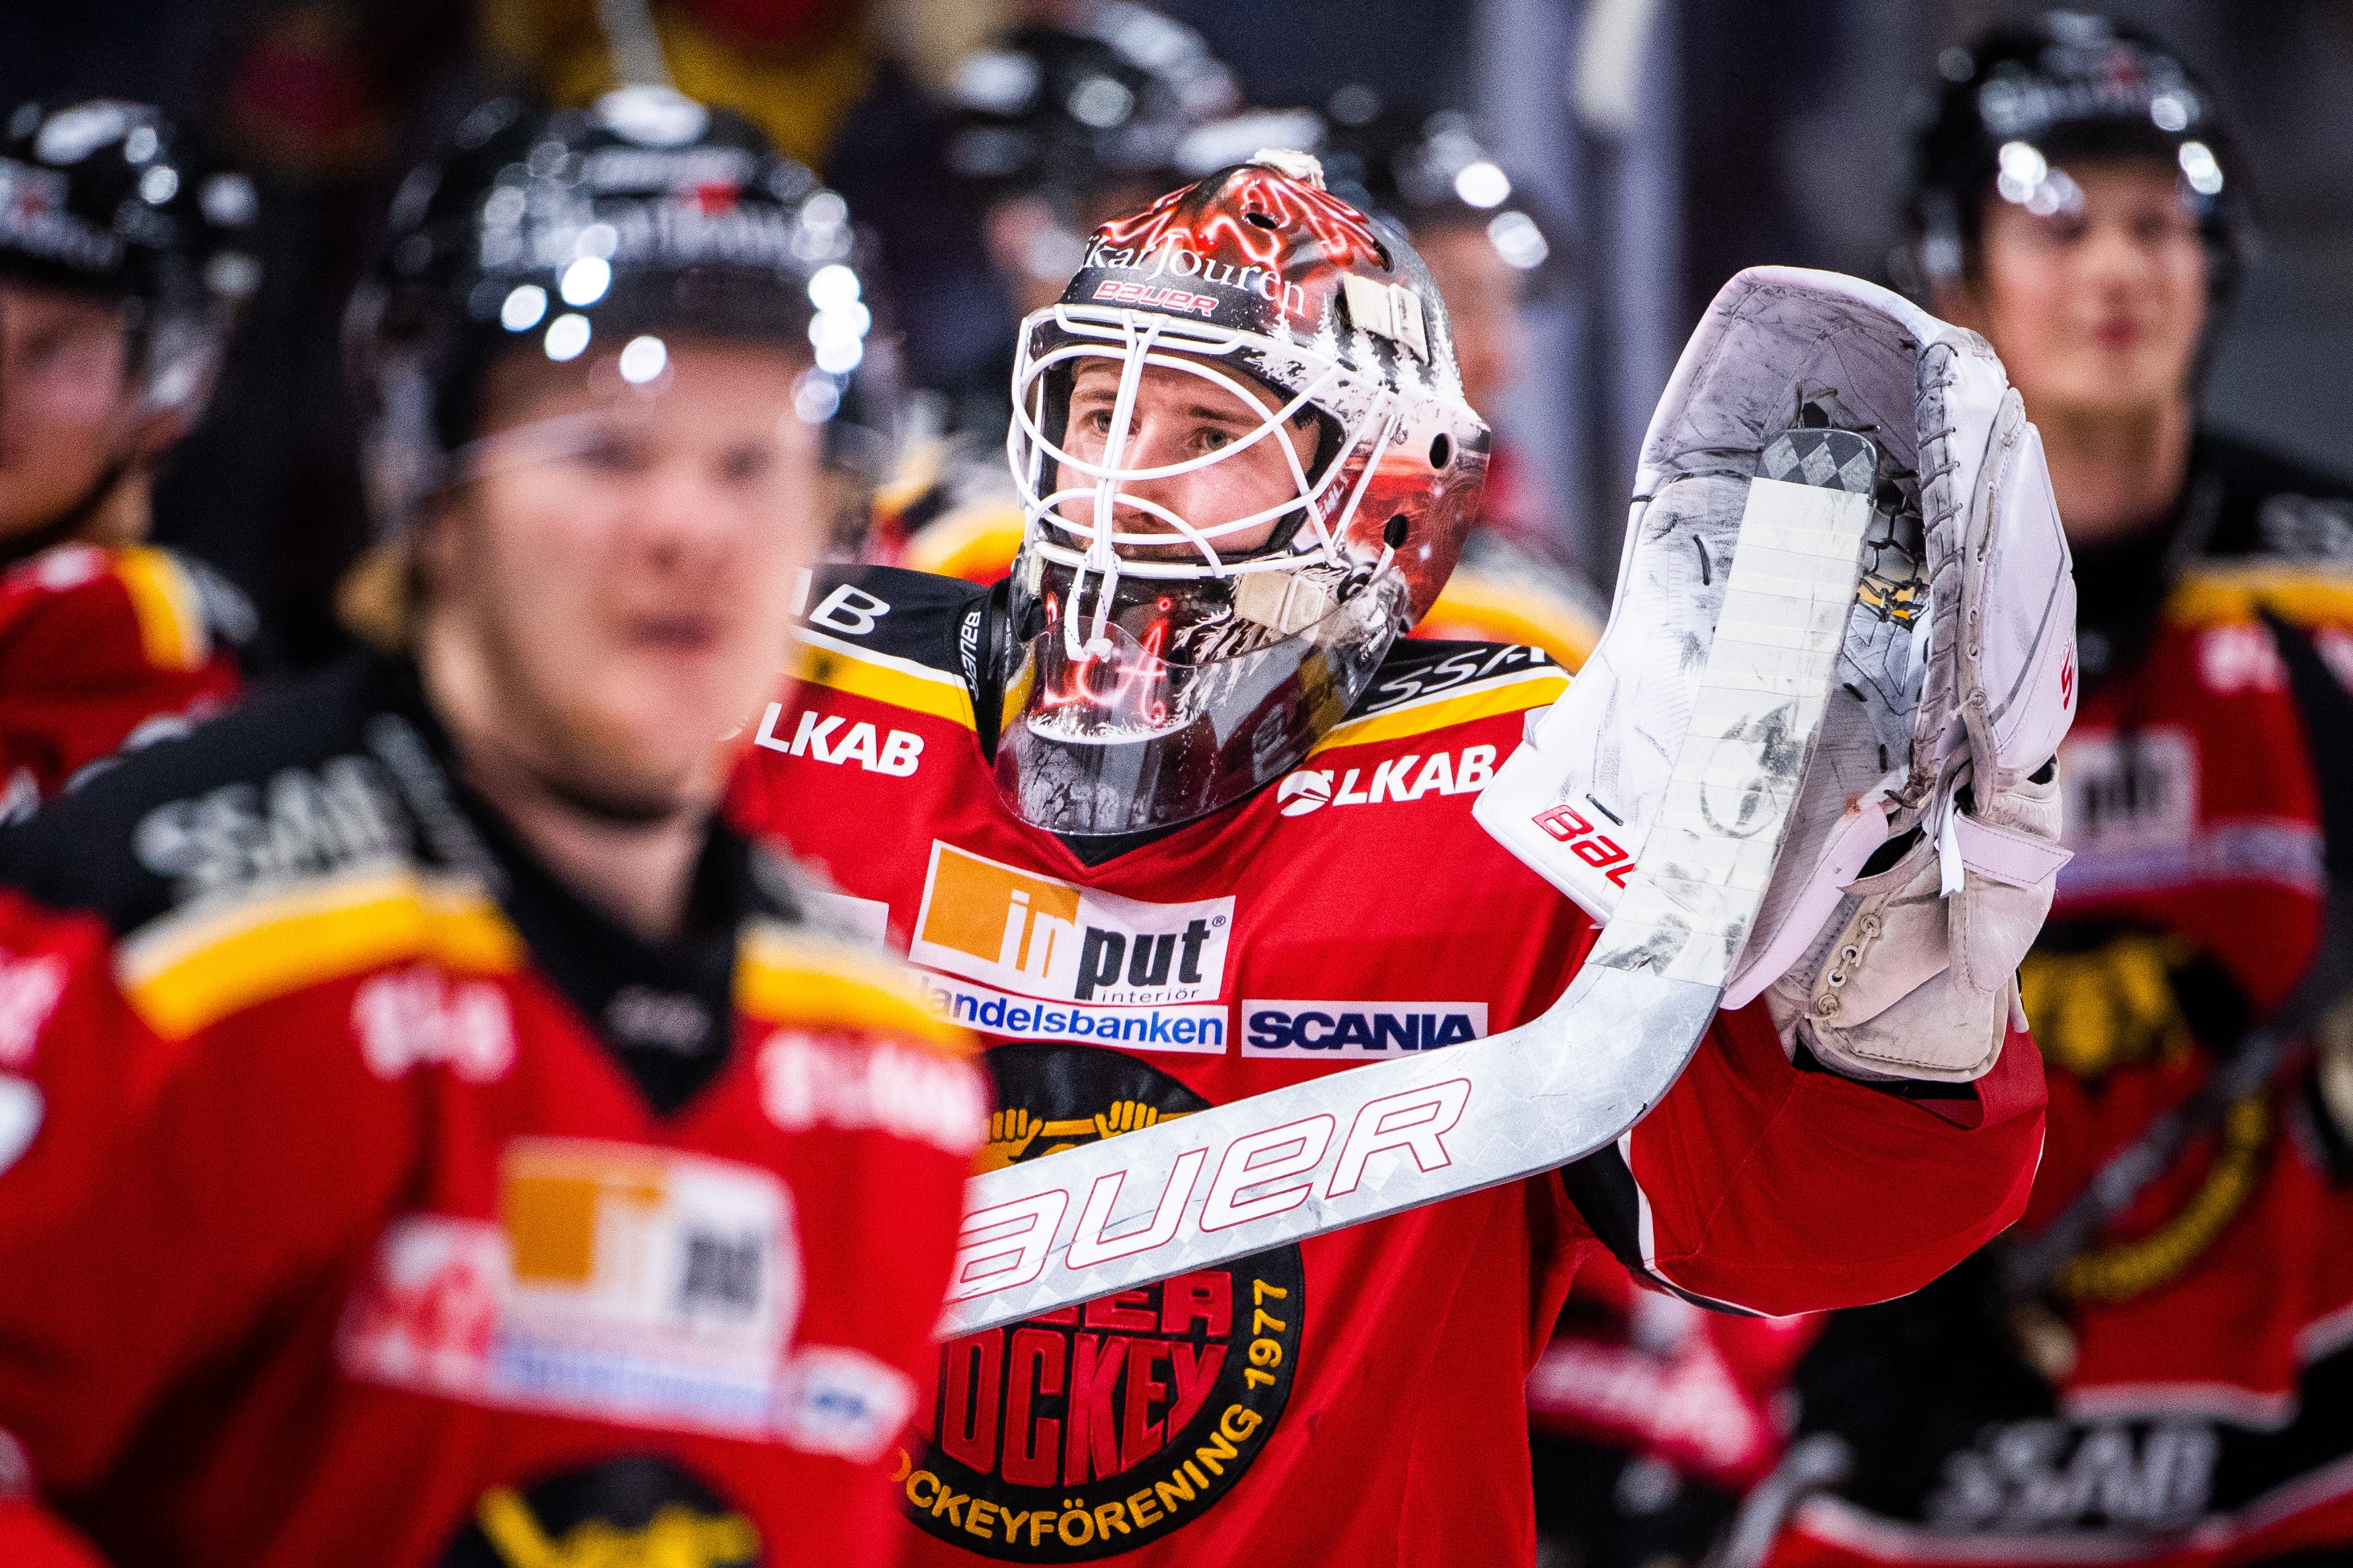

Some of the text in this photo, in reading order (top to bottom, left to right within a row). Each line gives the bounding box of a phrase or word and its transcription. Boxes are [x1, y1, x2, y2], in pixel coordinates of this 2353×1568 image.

[1092, 280, 1219, 318] BAUER
[1367, 645, 1545, 711] SSA
[754, 702, 925, 777] LKAB
[1332, 744, 1497, 807] LKAB
[921, 975, 1223, 1047] andelsbanken
[1102, 988, 1200, 1003] interiör
[1247, 1010, 1477, 1051] SCANIA
[944, 1076, 1472, 1306] AUER
[1243, 1278, 1288, 1389] 1977
